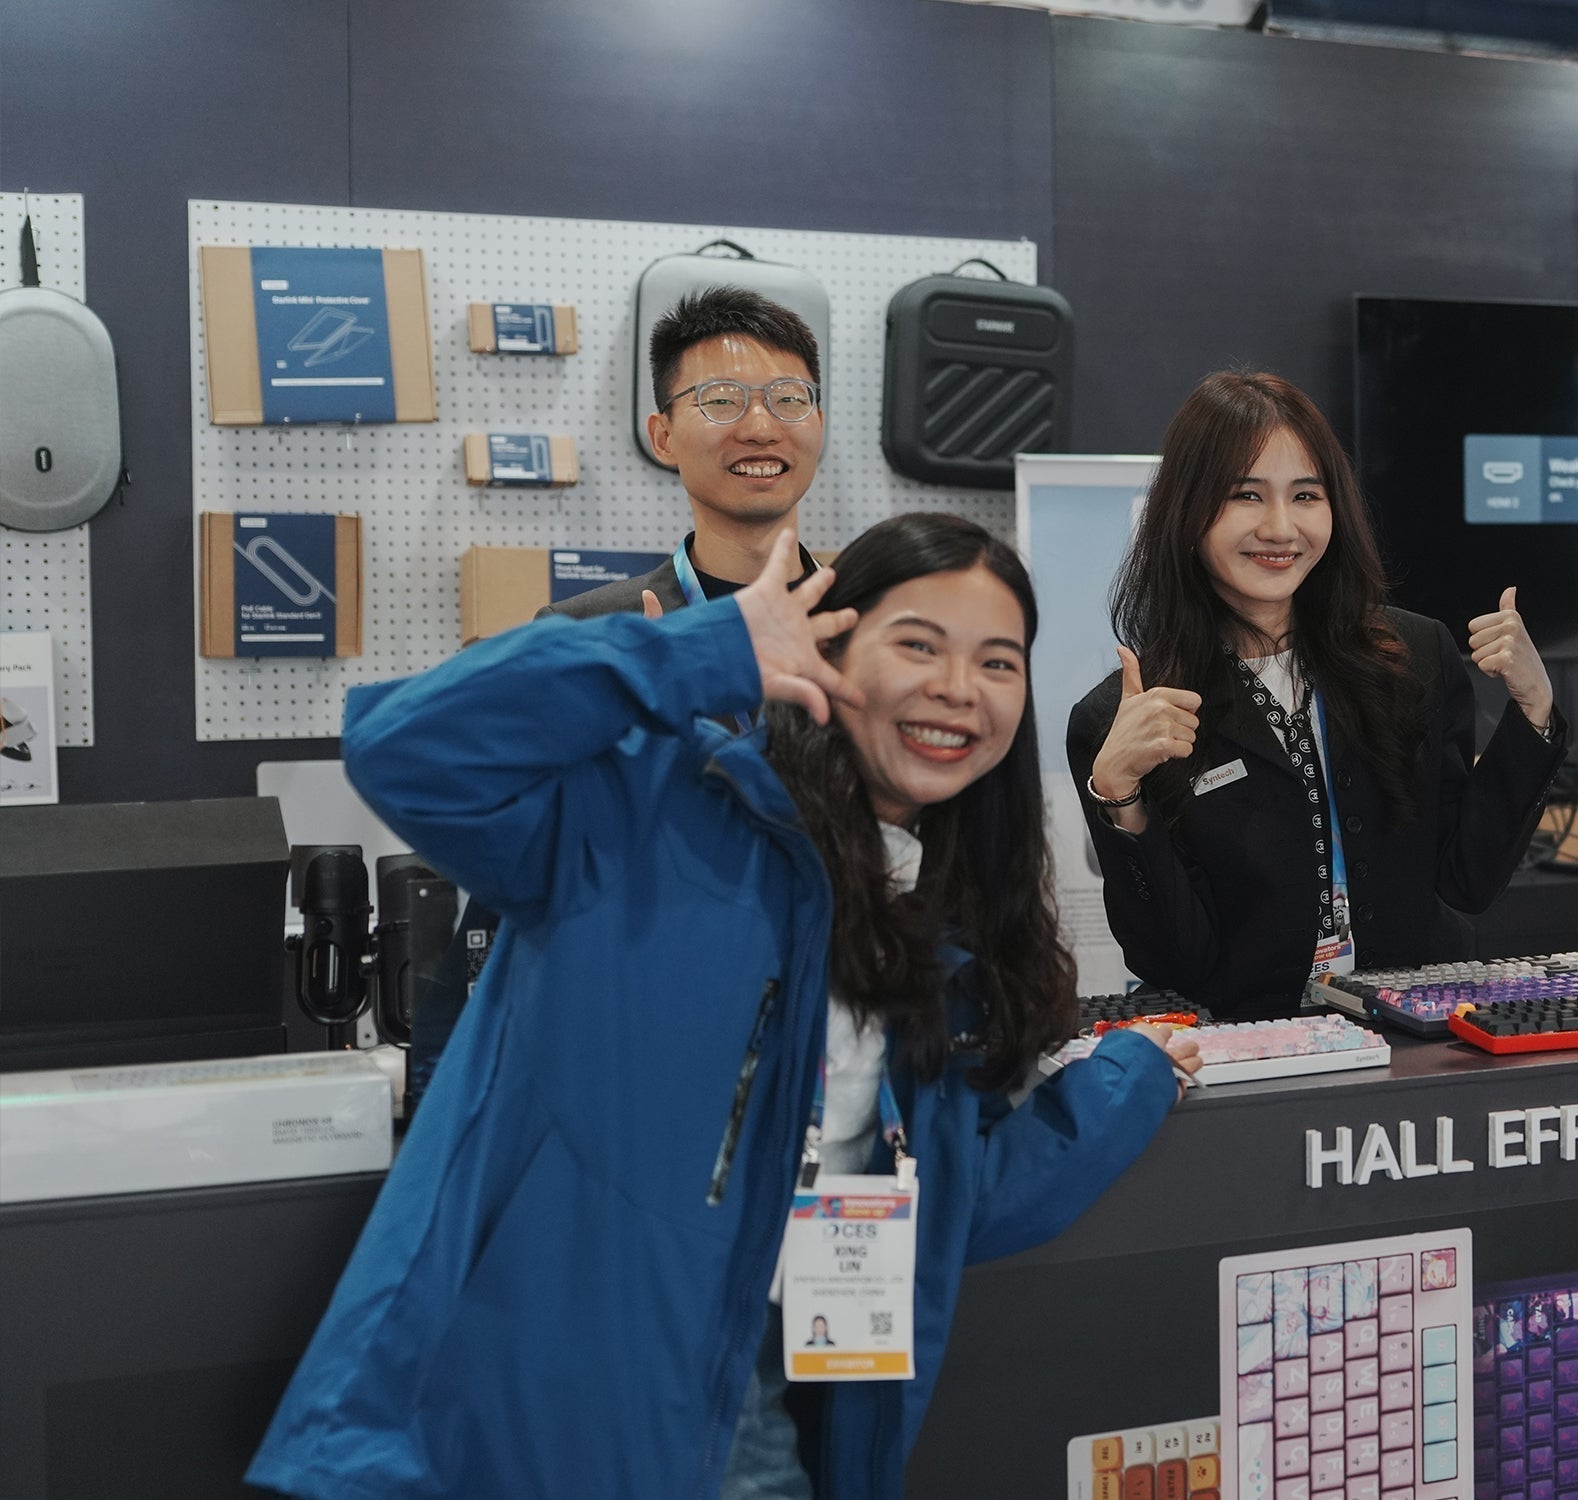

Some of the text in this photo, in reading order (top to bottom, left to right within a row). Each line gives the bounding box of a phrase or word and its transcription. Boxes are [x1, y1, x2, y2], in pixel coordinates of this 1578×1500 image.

[1203, 768, 1235, 785] Syntech
[1305, 1116, 1474, 1188] HALL
[842, 1223, 878, 1239] CES
[839, 1261, 861, 1273] LIN
[1326, 1340, 1342, 1357] A
[1290, 1367, 1306, 1382] Z
[1359, 1363, 1376, 1386] W
[1326, 1378, 1341, 1392] S
[1291, 1407, 1306, 1423] X
[1360, 1403, 1376, 1417] E
[1326, 1417, 1342, 1432] D
[1291, 1446, 1307, 1463] C
[1360, 1442, 1376, 1458] R
[1327, 1457, 1343, 1471] F
[1361, 1480, 1377, 1496] T
